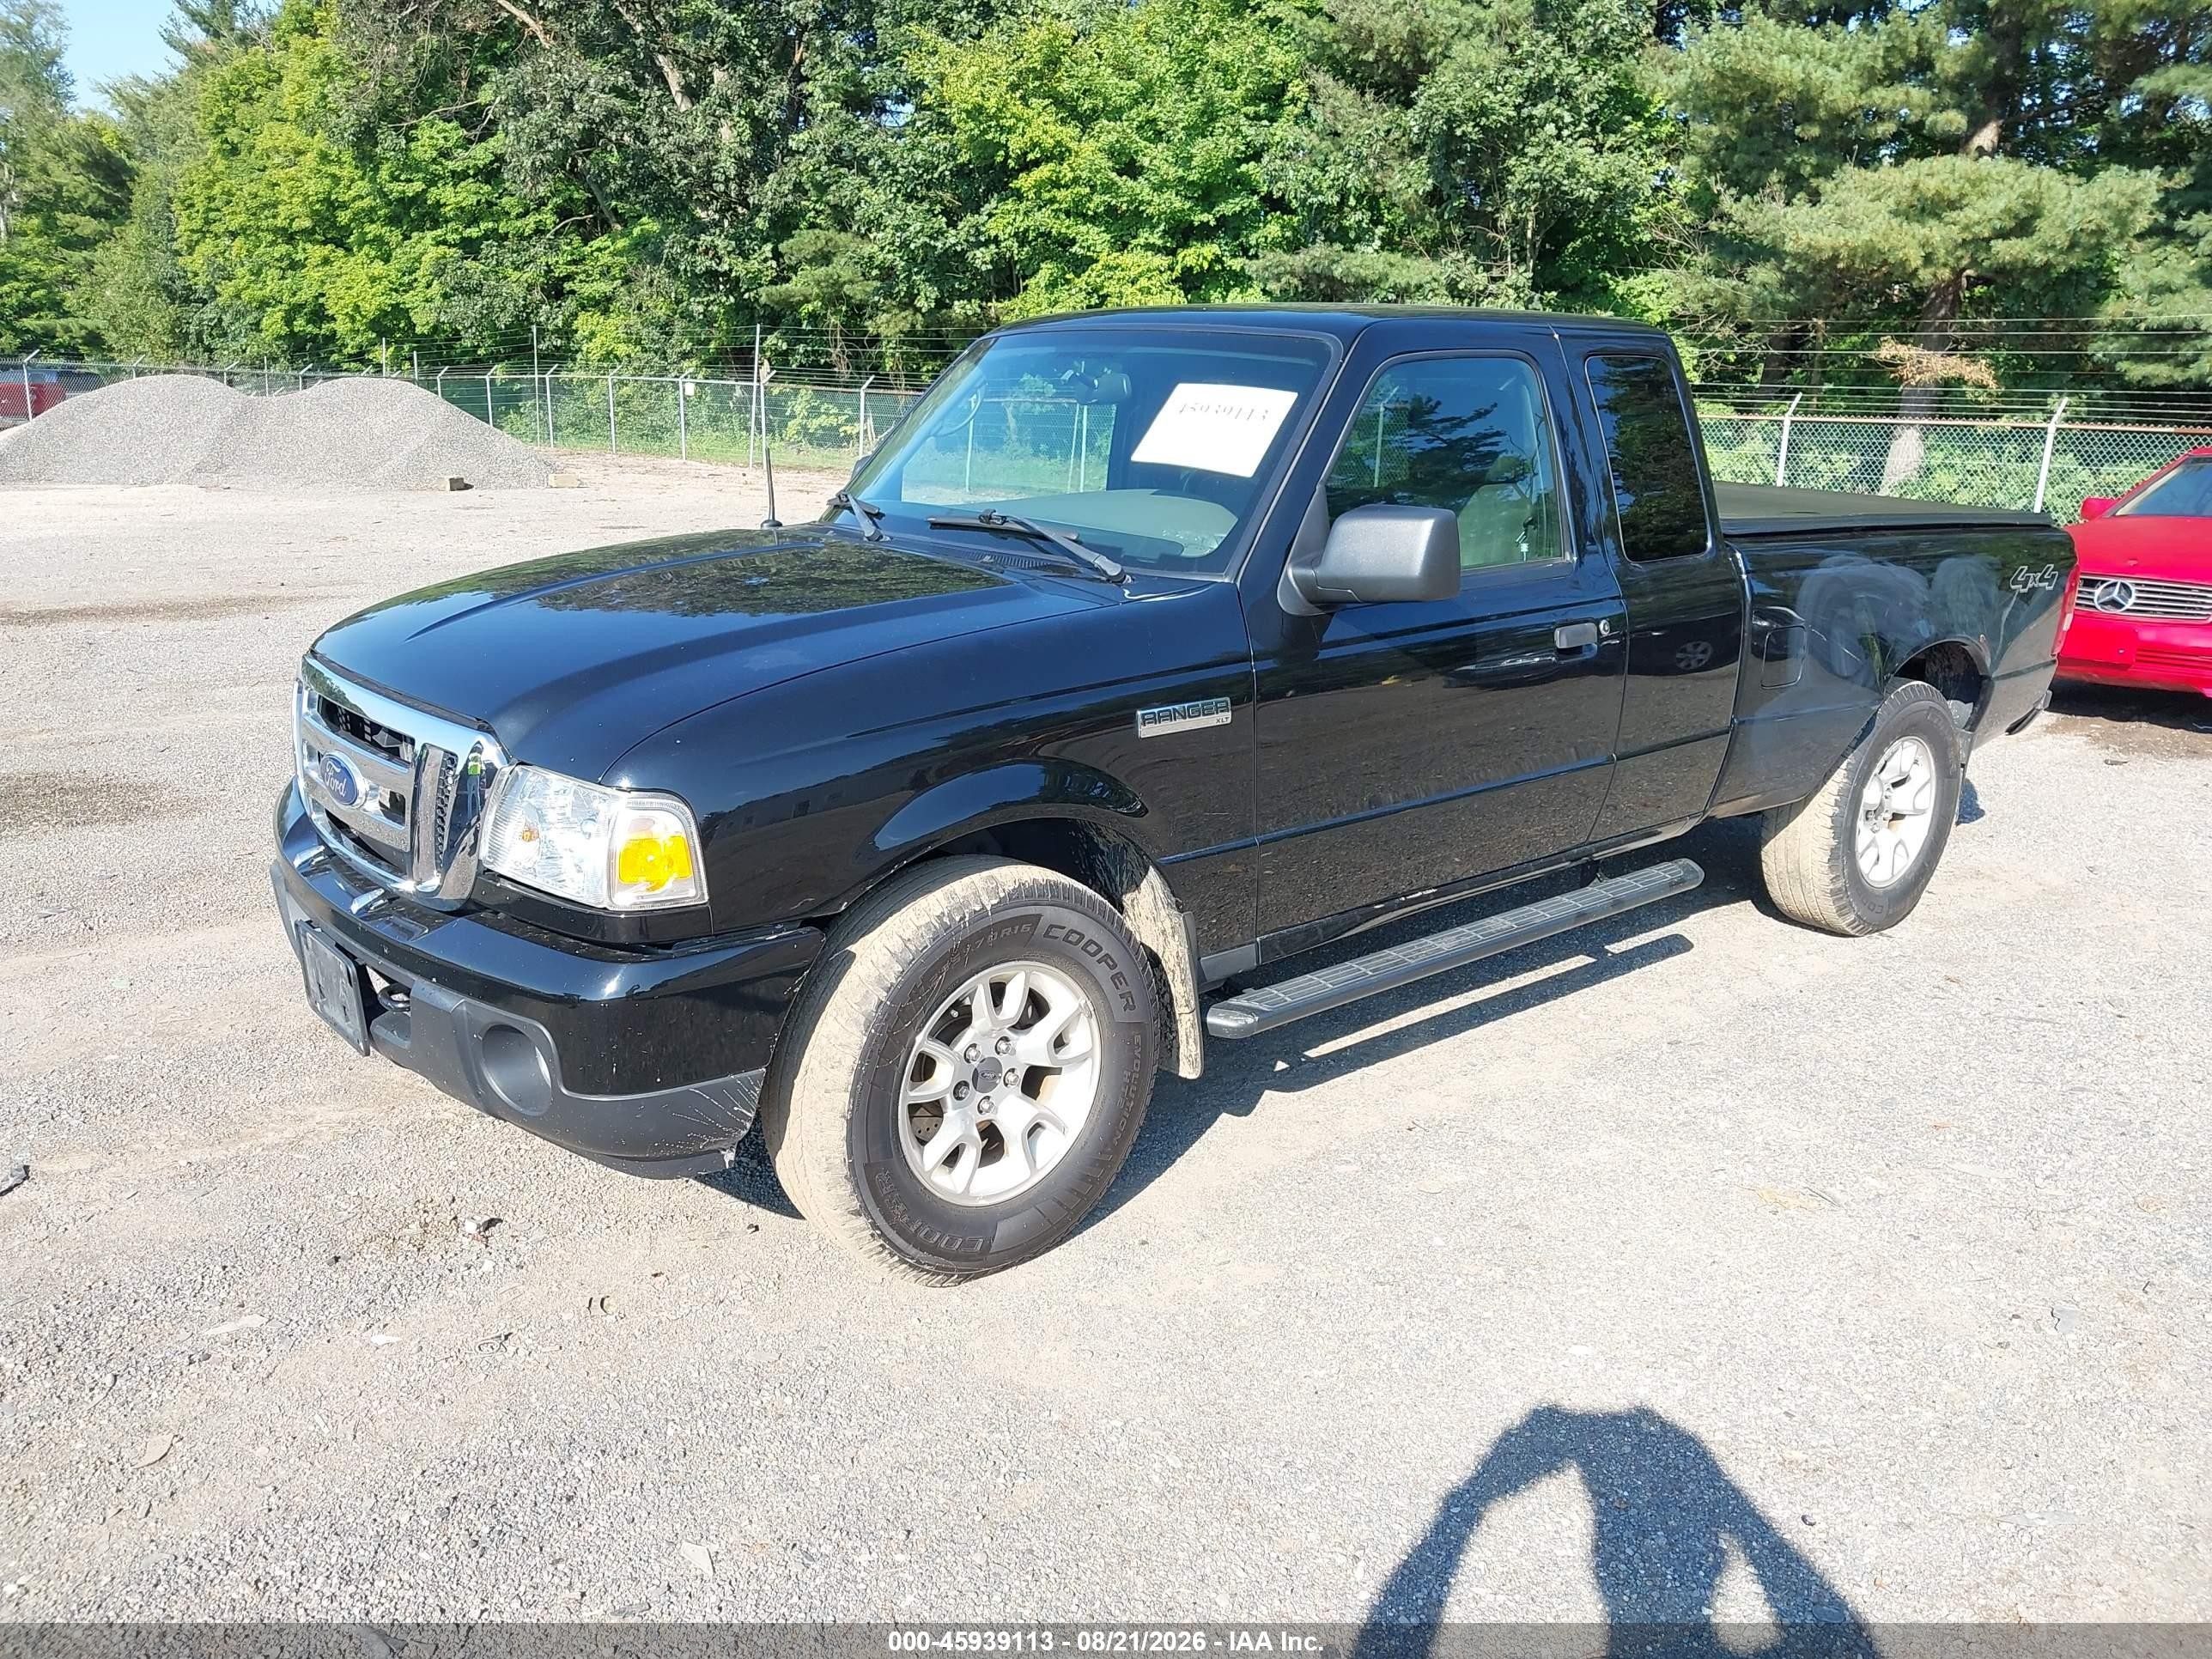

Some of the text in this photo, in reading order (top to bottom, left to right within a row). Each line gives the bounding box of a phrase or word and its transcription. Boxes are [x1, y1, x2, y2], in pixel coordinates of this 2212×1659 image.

[2010, 564, 2058, 592] 4x4
[1139, 700, 1230, 726] RANGER
[324, 761, 347, 797] Ford
[1042, 923, 1136, 1012] COOPER
[1113, 1034, 1141, 1146] EVOLUTION
